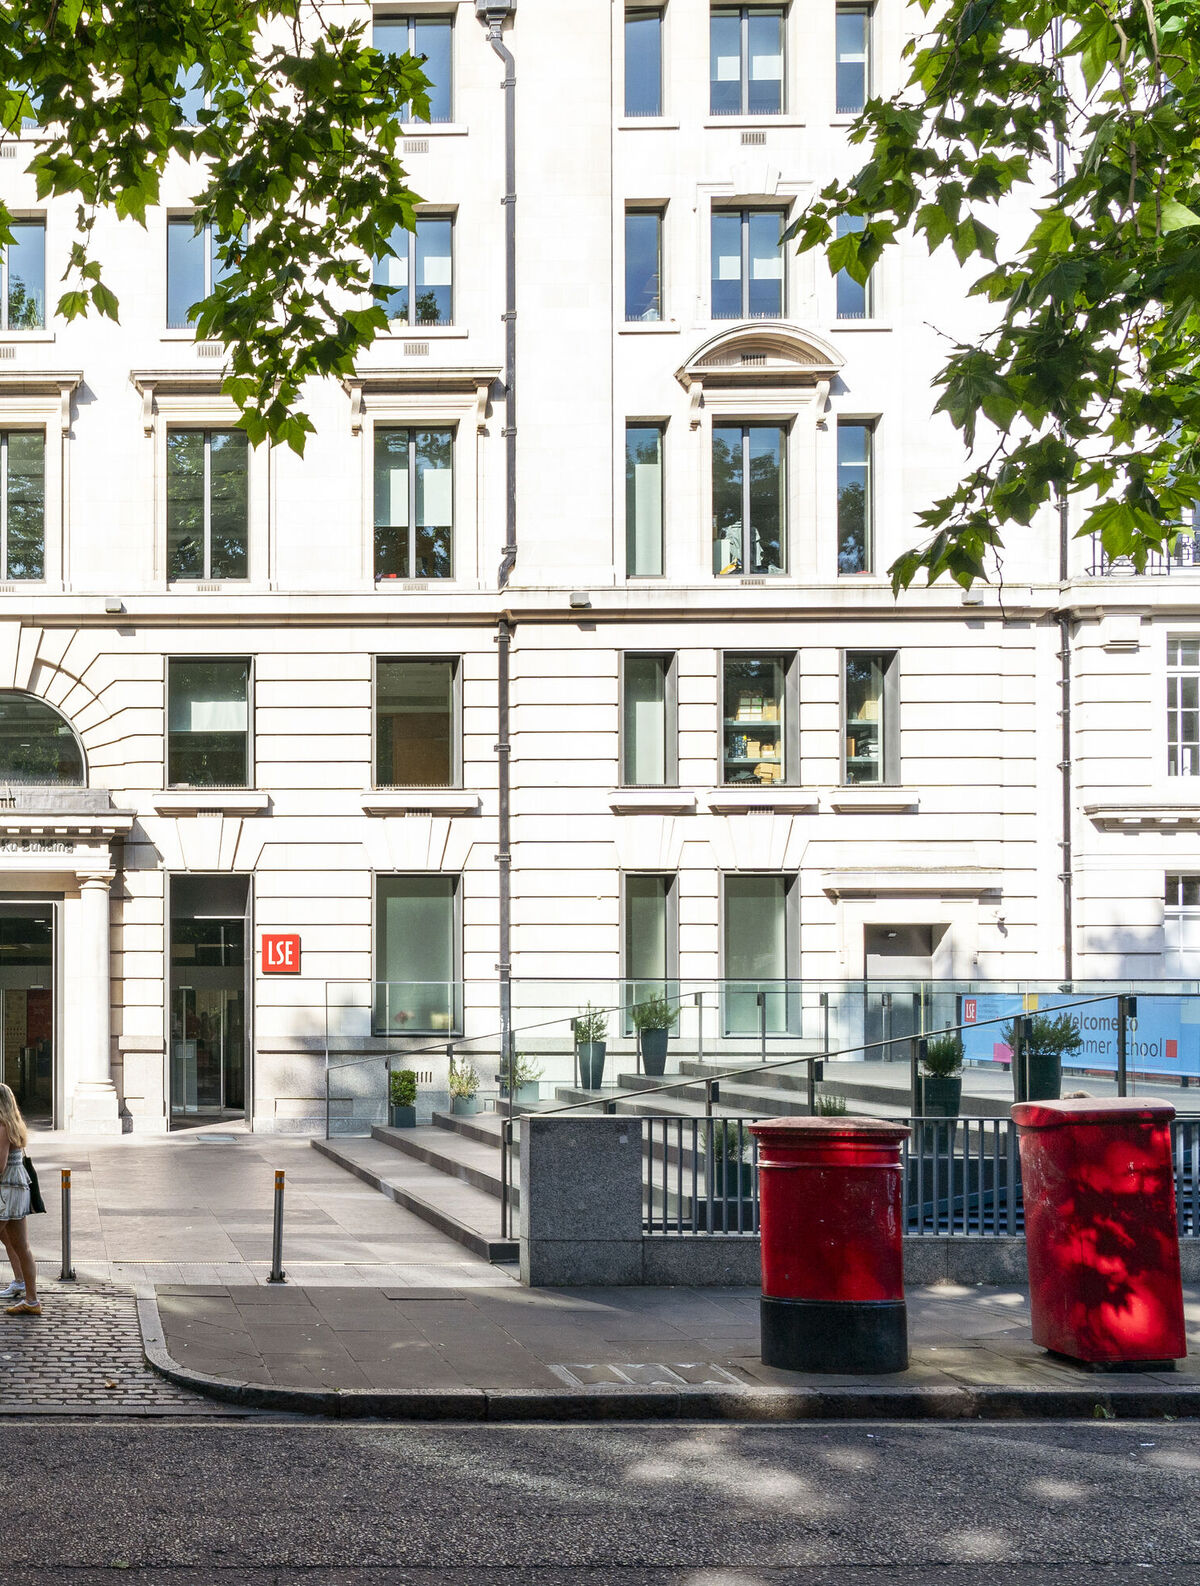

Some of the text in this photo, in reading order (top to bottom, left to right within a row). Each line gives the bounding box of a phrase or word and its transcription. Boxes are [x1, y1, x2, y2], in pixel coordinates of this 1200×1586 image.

[1, 838, 18, 852] Ku
[21, 838, 75, 854] Building
[268, 940, 293, 965] LSE
[966, 1003, 976, 1019] LSE
[1059, 1011, 1120, 1031] Welcome
[1117, 1037, 1163, 1057] chool
